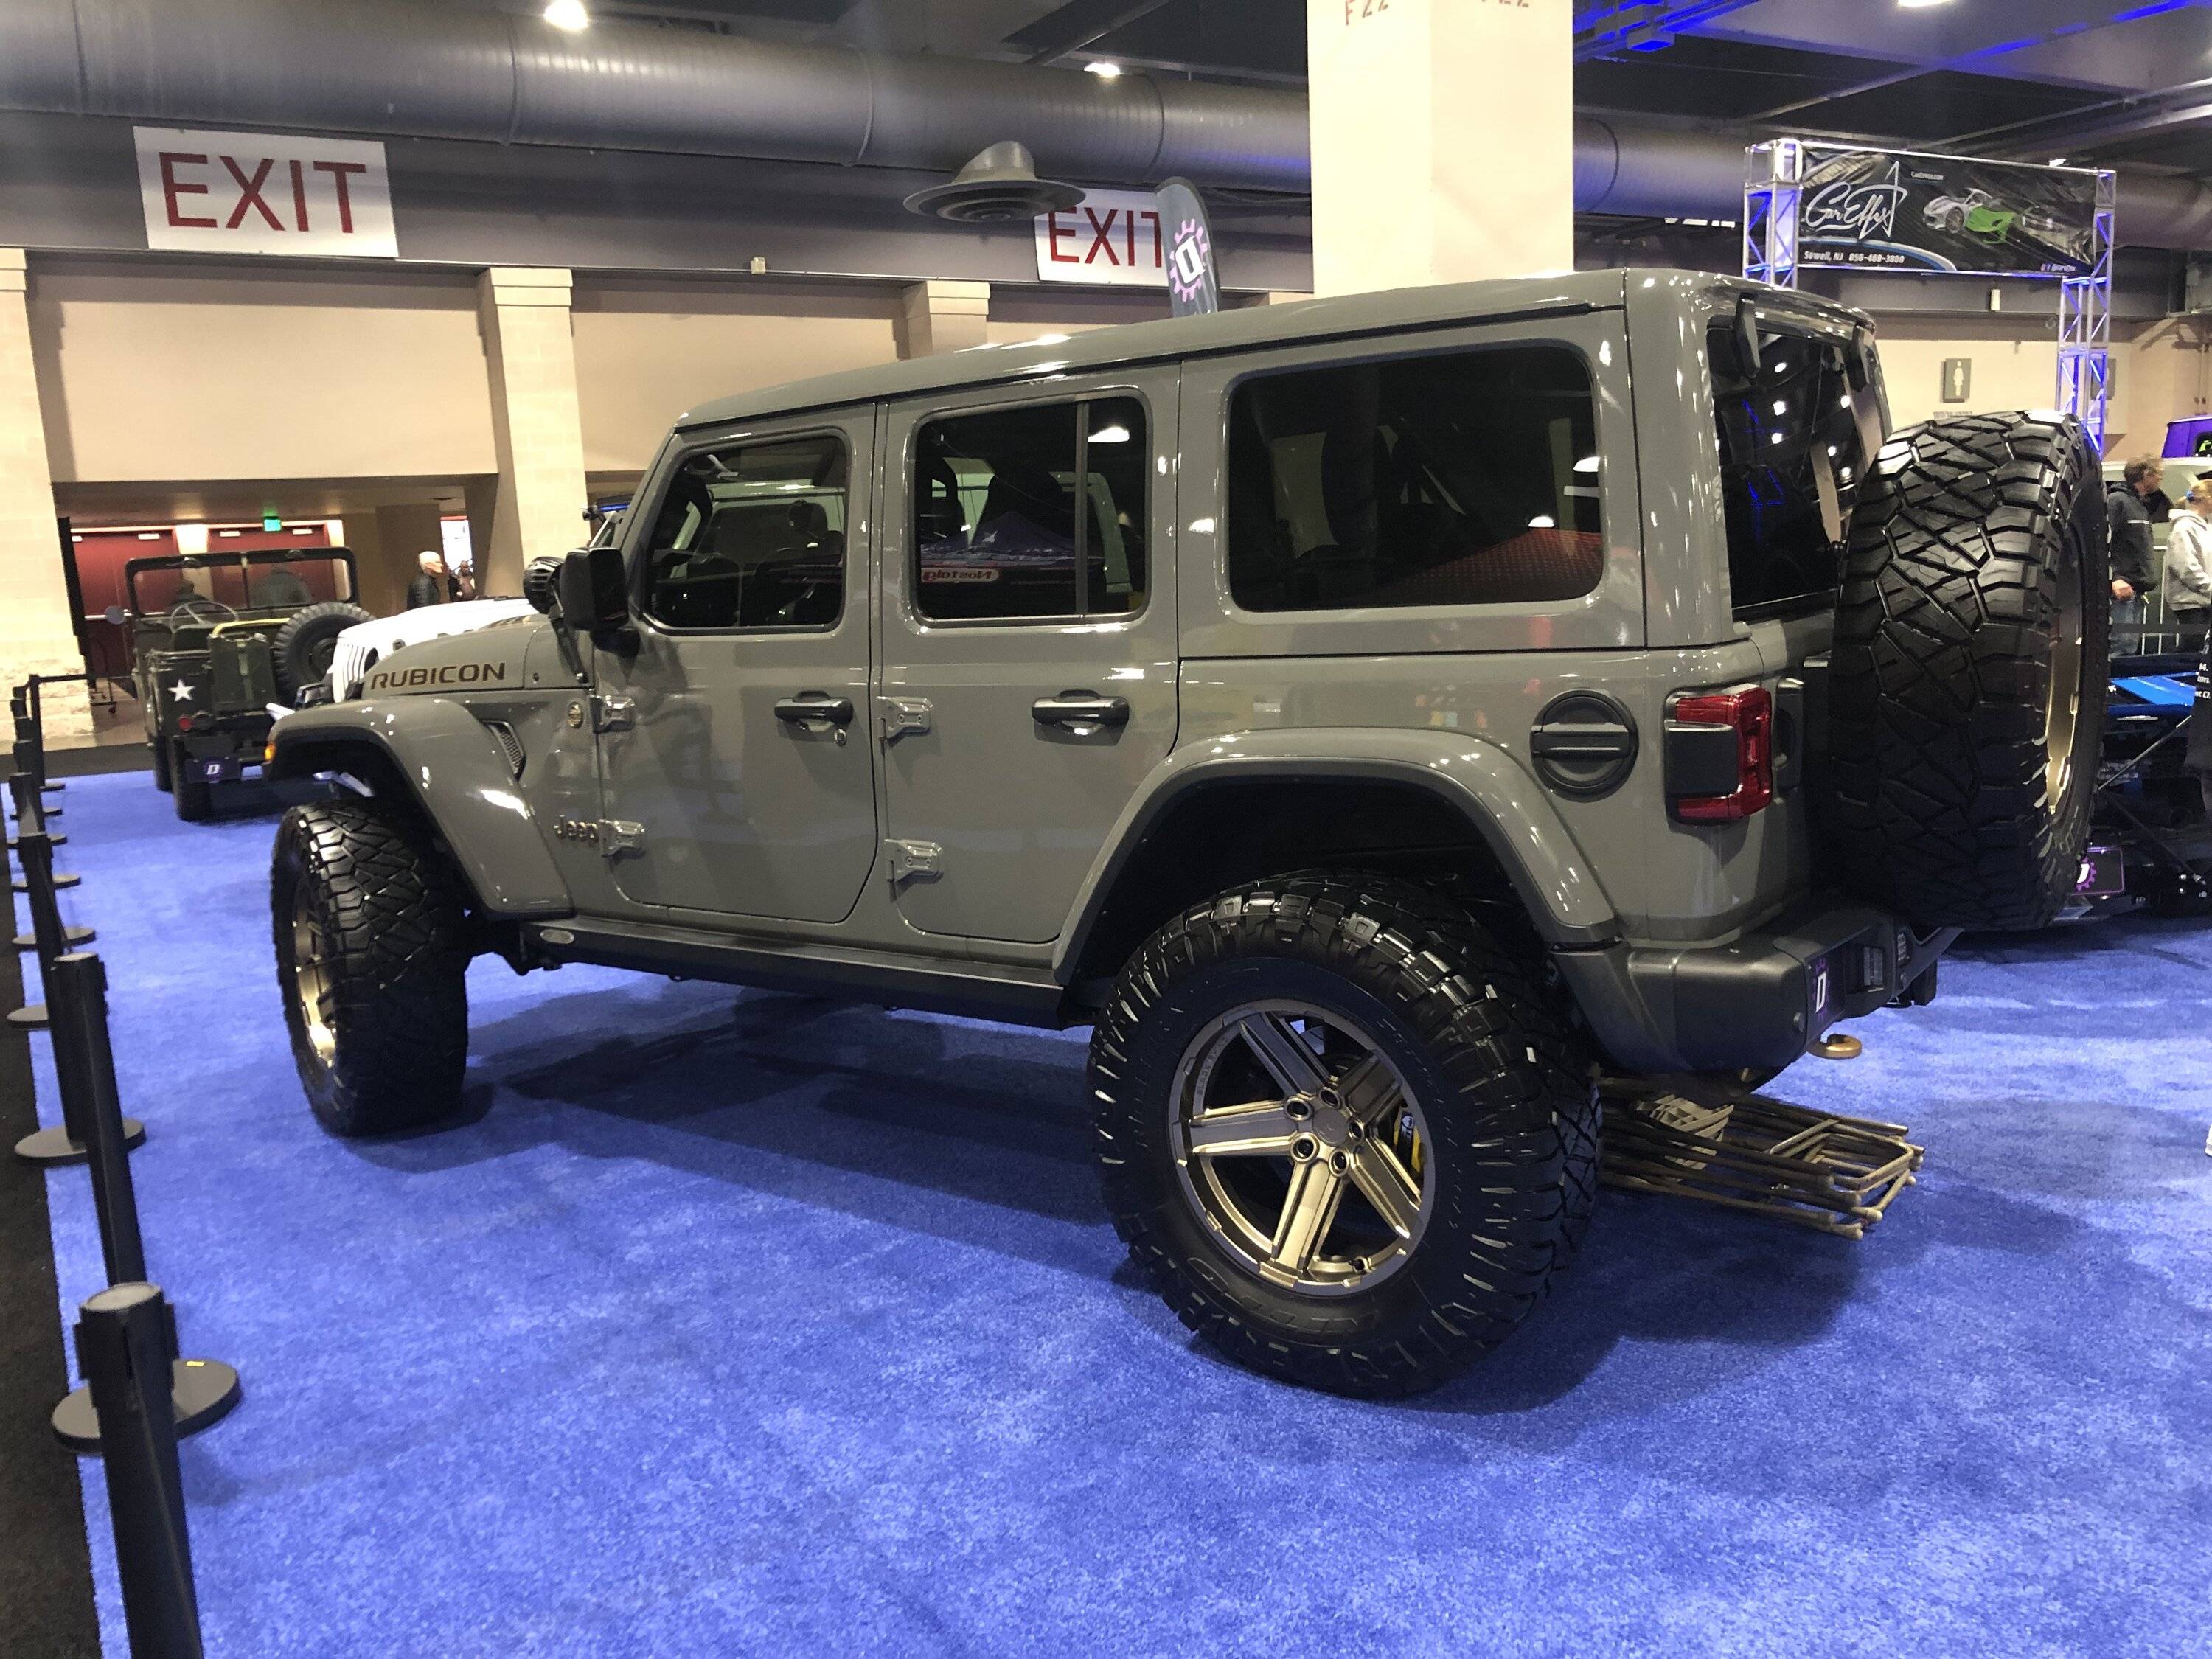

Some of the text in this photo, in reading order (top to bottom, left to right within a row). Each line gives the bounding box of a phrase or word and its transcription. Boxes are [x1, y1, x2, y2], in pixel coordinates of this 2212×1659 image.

[159, 151, 366, 234] EXIT
[1047, 206, 1163, 268] EXIT
[1833, 252, 1844, 261] NJ
[370, 662, 506, 690] RUBICON
[554, 815, 599, 843] Jeep
